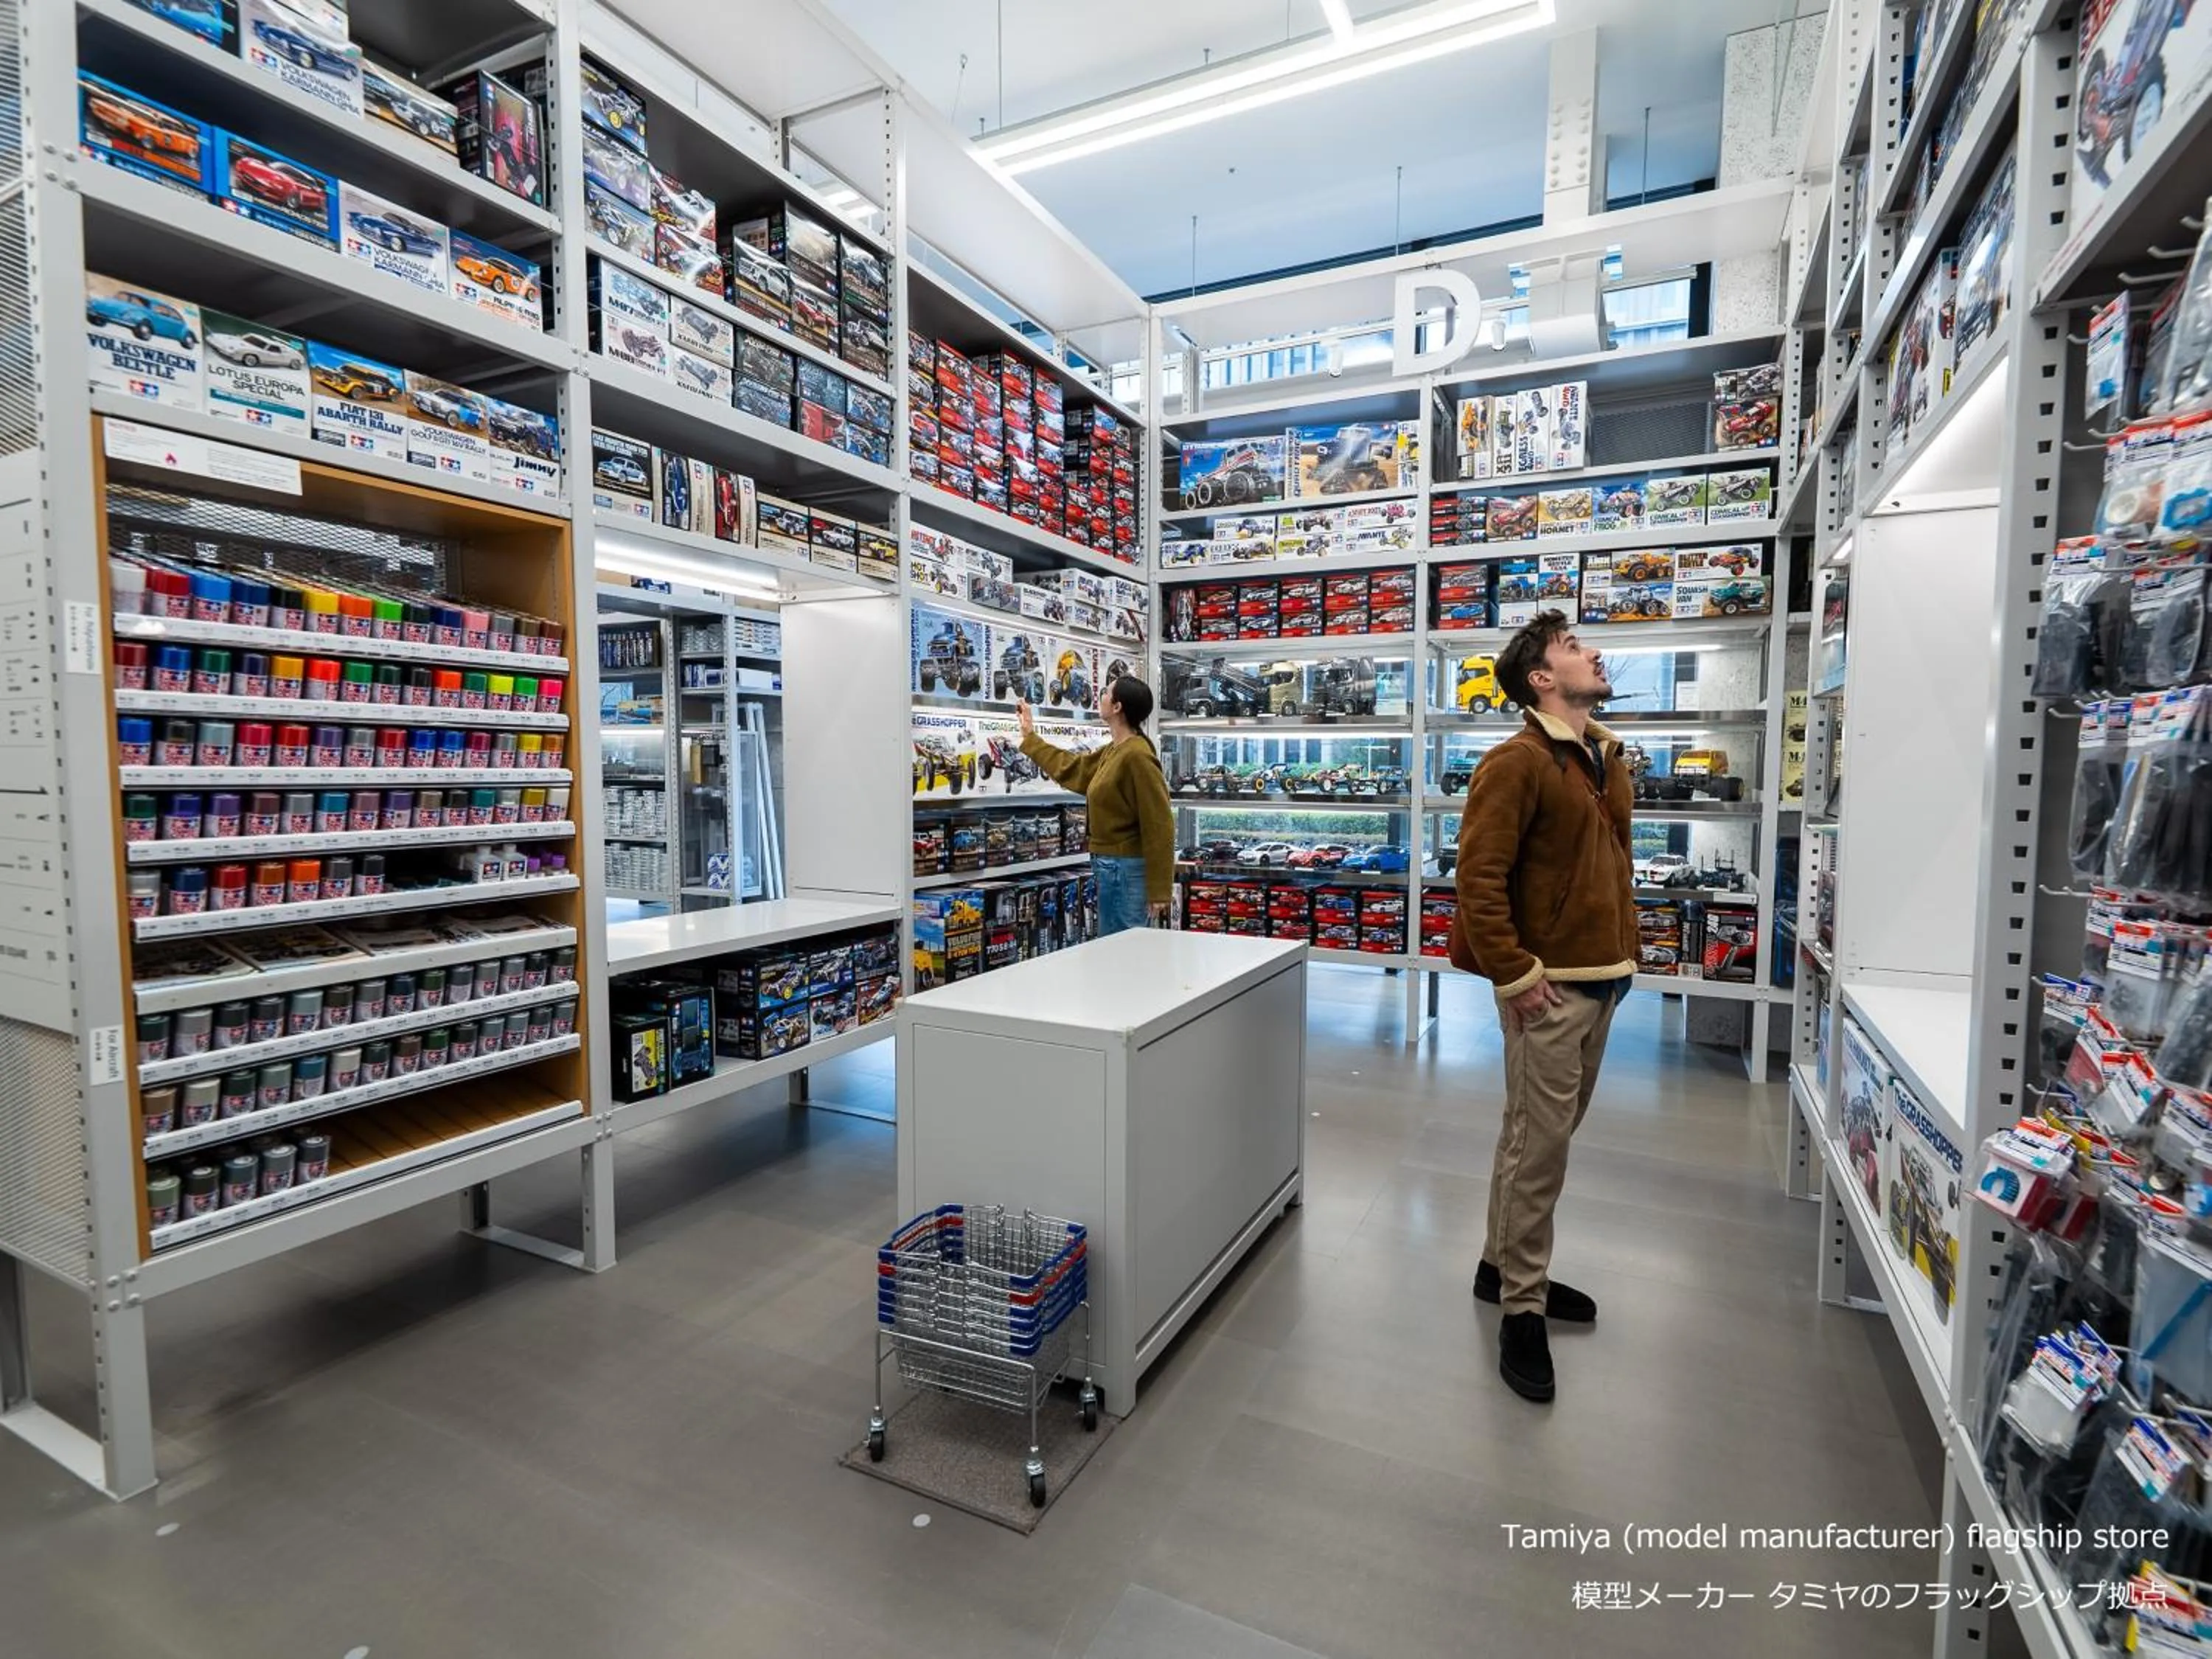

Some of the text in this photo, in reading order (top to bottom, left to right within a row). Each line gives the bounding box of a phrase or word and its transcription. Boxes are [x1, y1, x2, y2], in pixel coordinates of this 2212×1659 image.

[1392, 268, 1481, 377] D
[87, 333, 196, 372] VOLKSWAGEN
[113, 353, 175, 380] BEETLE
[208, 364, 305, 397] LOTUS EUROPA
[232, 380, 285, 400] SPECIAL
[318, 406, 403, 435] ABARTH RALLY
[340, 401, 366, 416] FIAT
[1540, 525, 1574, 535] HORNET
[108, 1029, 119, 1079] For Aircraft
